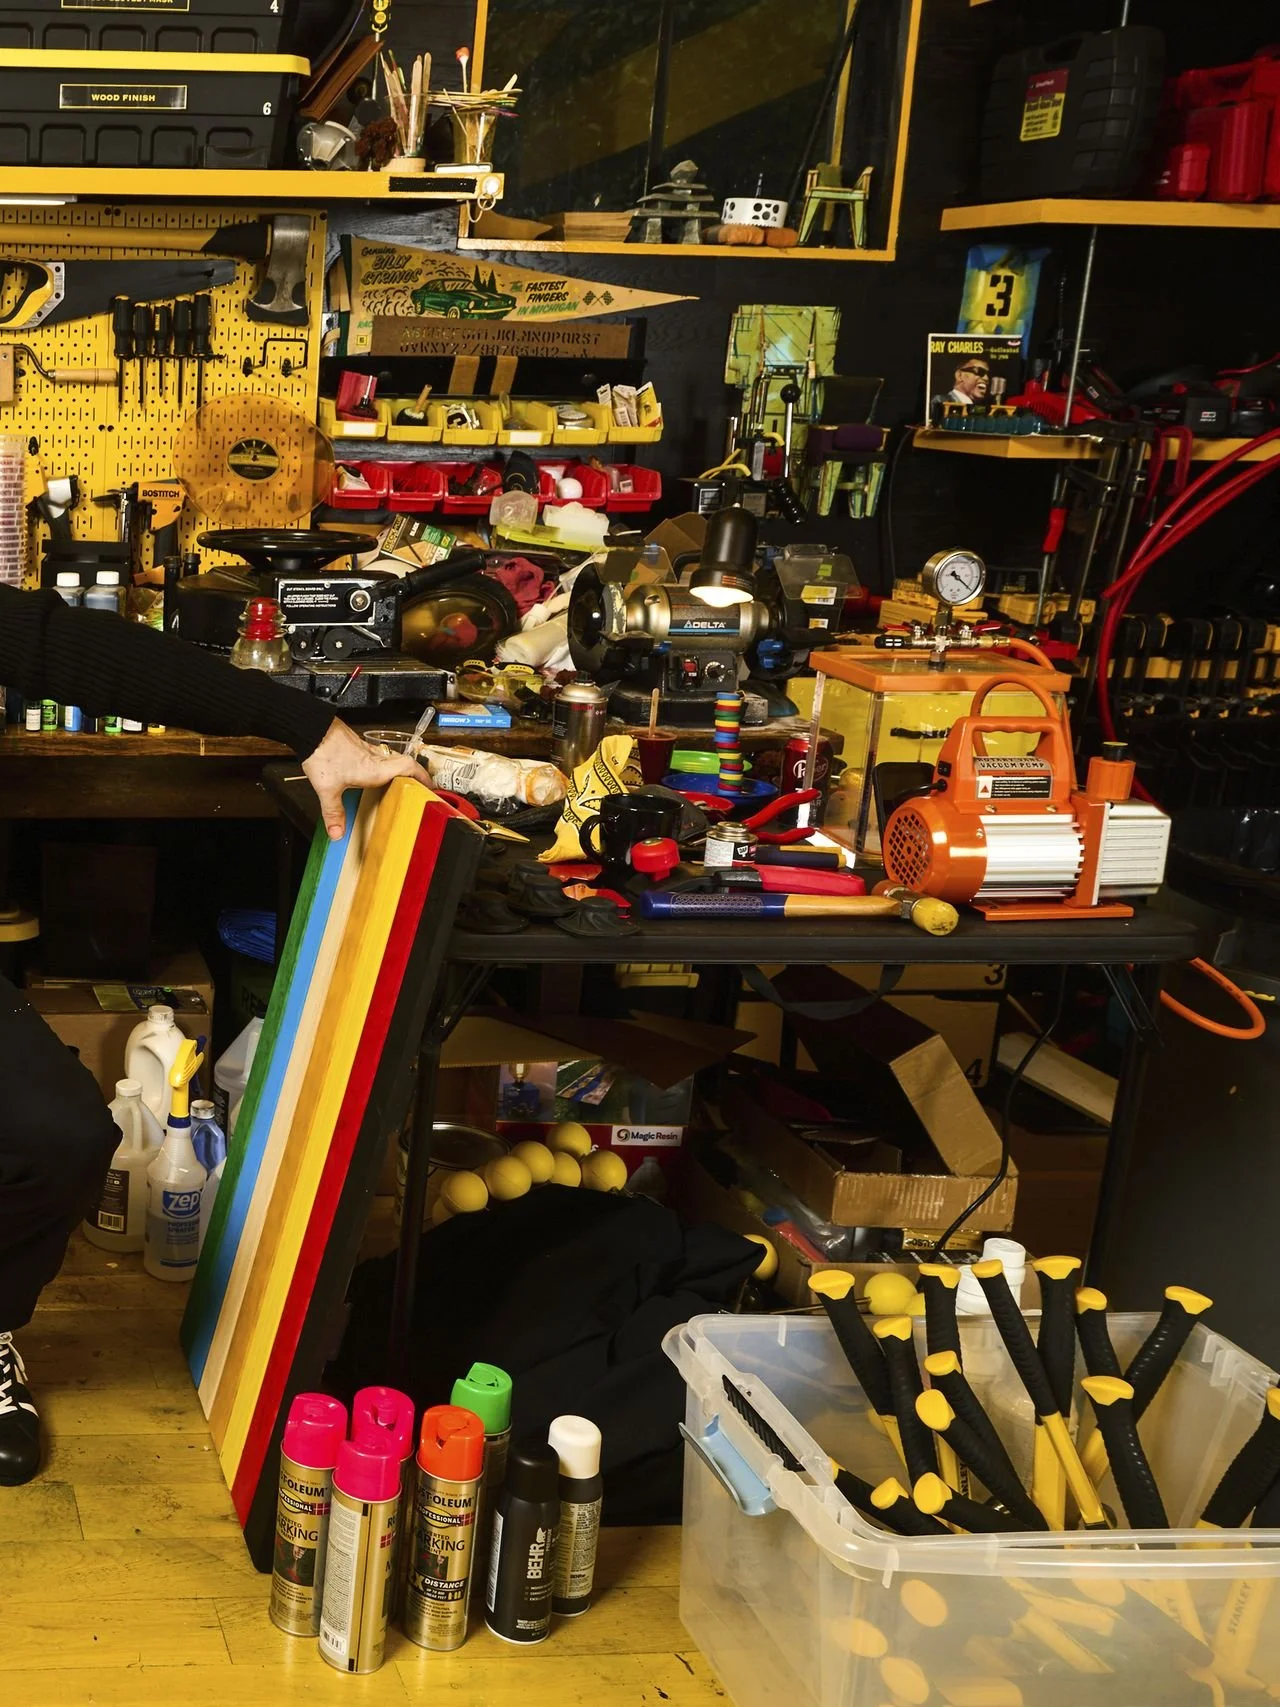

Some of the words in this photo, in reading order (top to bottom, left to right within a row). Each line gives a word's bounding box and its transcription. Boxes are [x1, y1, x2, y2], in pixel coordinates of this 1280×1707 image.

[270, 0, 279, 13] 4
[122, 94, 156, 102] FINISH
[262, 102, 272, 115] 6
[361, 246, 396, 256] Genuine
[372, 254, 412, 270] BILLY
[361, 268, 422, 285] STRINGS
[525, 281, 568, 292] FASTEST
[526, 291, 569, 303] FINGERS
[985, 274, 1015, 317] 3
[516, 305, 529, 316] IN
[529, 301, 580, 314] MICHIGAN
[930, 341, 946, 353] RAY
[947, 341, 984, 353] CHARLES
[142, 489, 180, 498] BOSTITCH
[692, 621, 726, 629] DELTA
[984, 963, 1004, 985] 3
[631, 1132, 655, 1142] Magic
[656, 1132, 678, 1140] Resin
[280, 1472, 325, 1497] T-OLEUM
[526, 1542, 545, 1579] BEHR
[424, 1578, 465, 1590] DISTANCE
[1227, 1582, 1253, 1635] STANLEY
